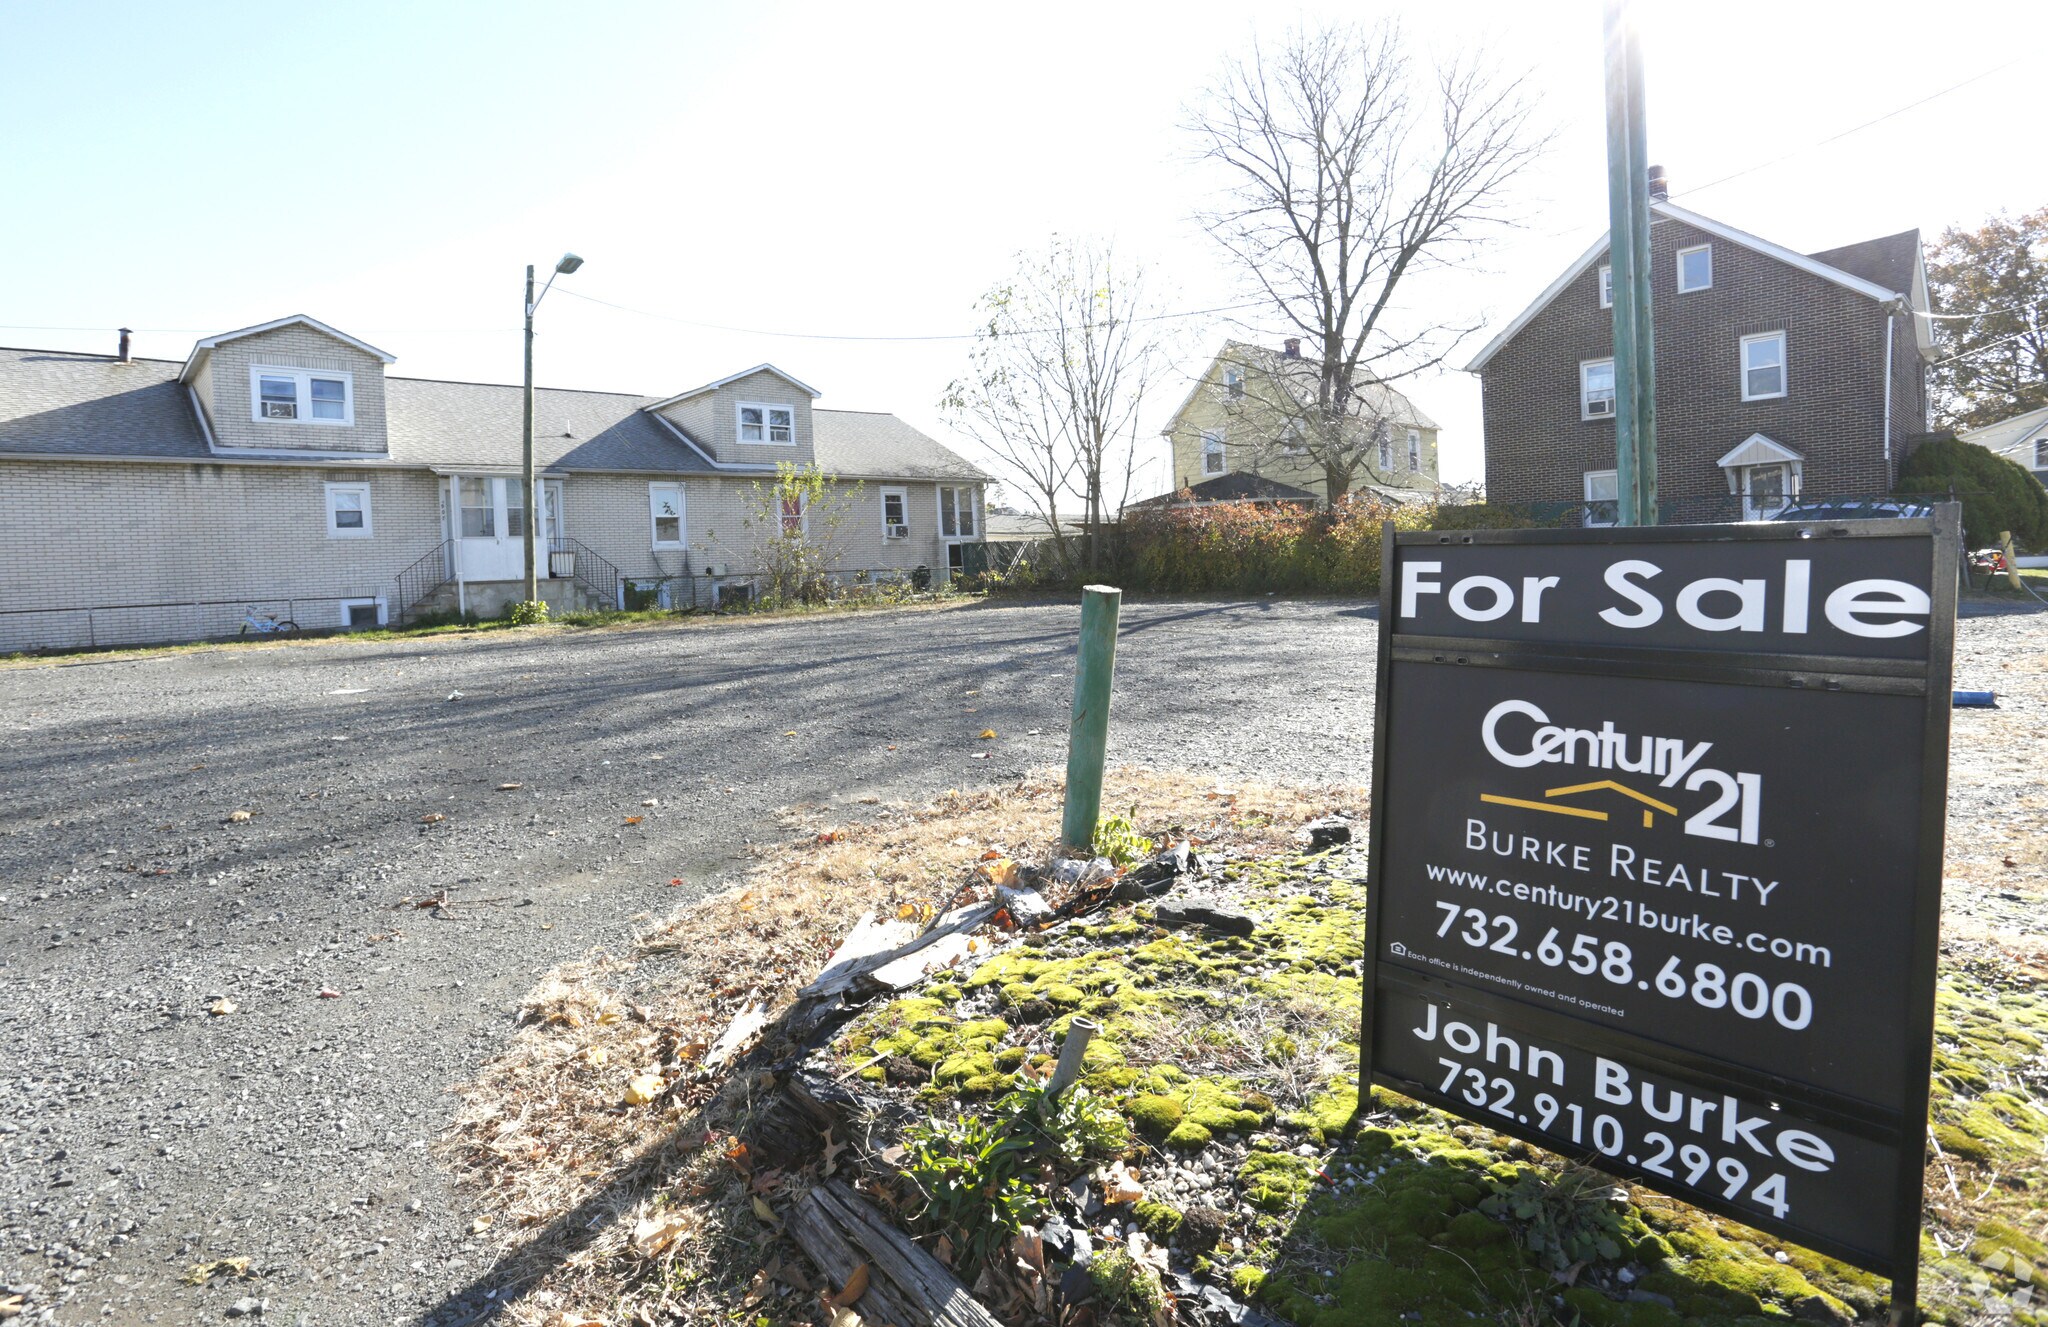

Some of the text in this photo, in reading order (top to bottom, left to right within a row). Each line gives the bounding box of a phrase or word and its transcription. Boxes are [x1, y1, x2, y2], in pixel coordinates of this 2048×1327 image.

[1400, 559, 1931, 639] For Sale
[1482, 699, 1714, 788] Century
[1685, 768, 1762, 846] 21
[1465, 818, 1779, 906] BURKE REALTY
[1426, 863, 1831, 968] www.century21burke.com
[1407, 951, 1625, 1017] Each office is independently owned and operated
[1436, 900, 1813, 1031] 732.658.6800
[1412, 1003, 1835, 1172] John Burke
[1438, 1056, 1790, 1219] 732.910.2994
